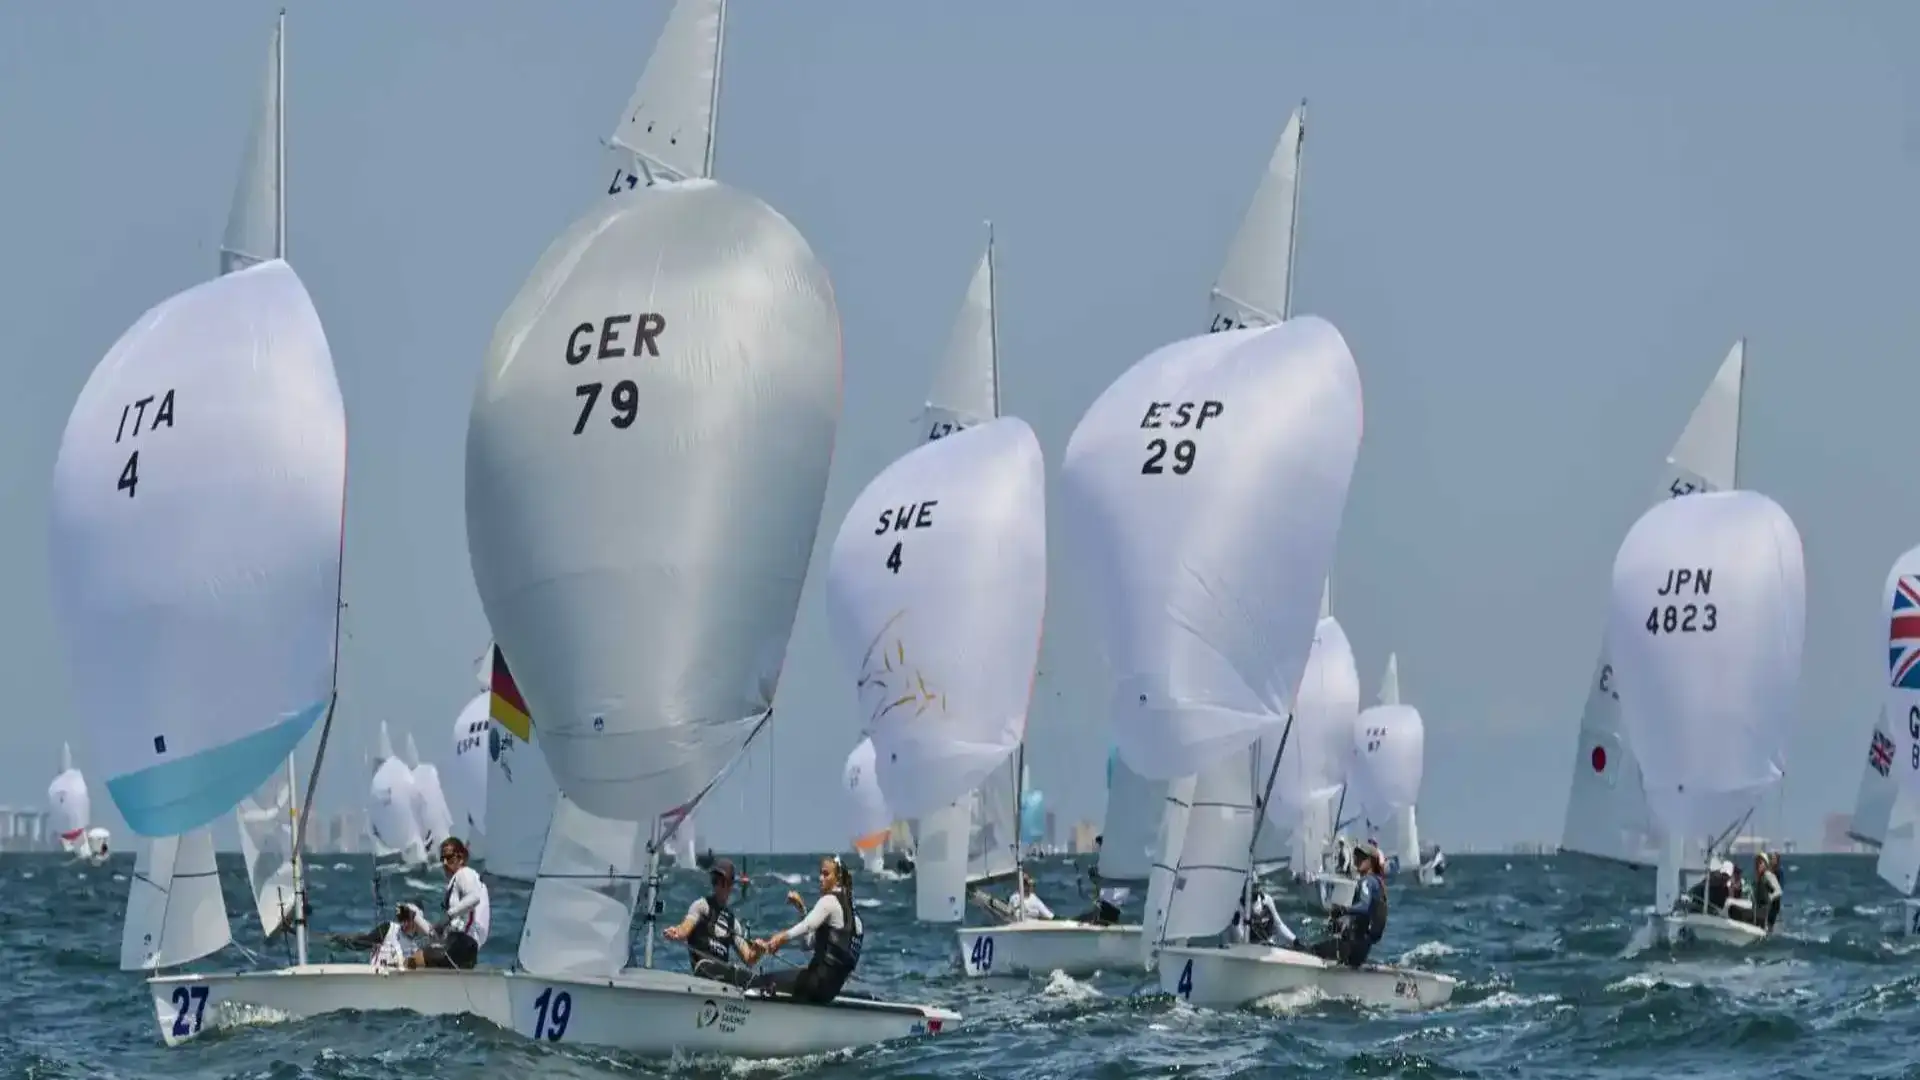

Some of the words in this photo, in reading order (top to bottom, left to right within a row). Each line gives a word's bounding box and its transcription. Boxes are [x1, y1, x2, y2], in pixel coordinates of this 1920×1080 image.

[565, 313, 666, 366] GER
[115, 389, 175, 443] ITA
[572, 380, 639, 435] 79
[1140, 401, 1224, 430] ESP
[117, 450, 139, 498] 4
[1141, 438, 1196, 475] 29
[874, 500, 938, 536] SWE
[886, 542, 904, 574] 4
[1657, 569, 1713, 596] JPN
[1644, 604, 1718, 636] 4823
[971, 935, 994, 971] 40
[1177, 958, 1193, 1000] 4
[171, 985, 210, 1037] 27
[534, 987, 572, 1044] 19
